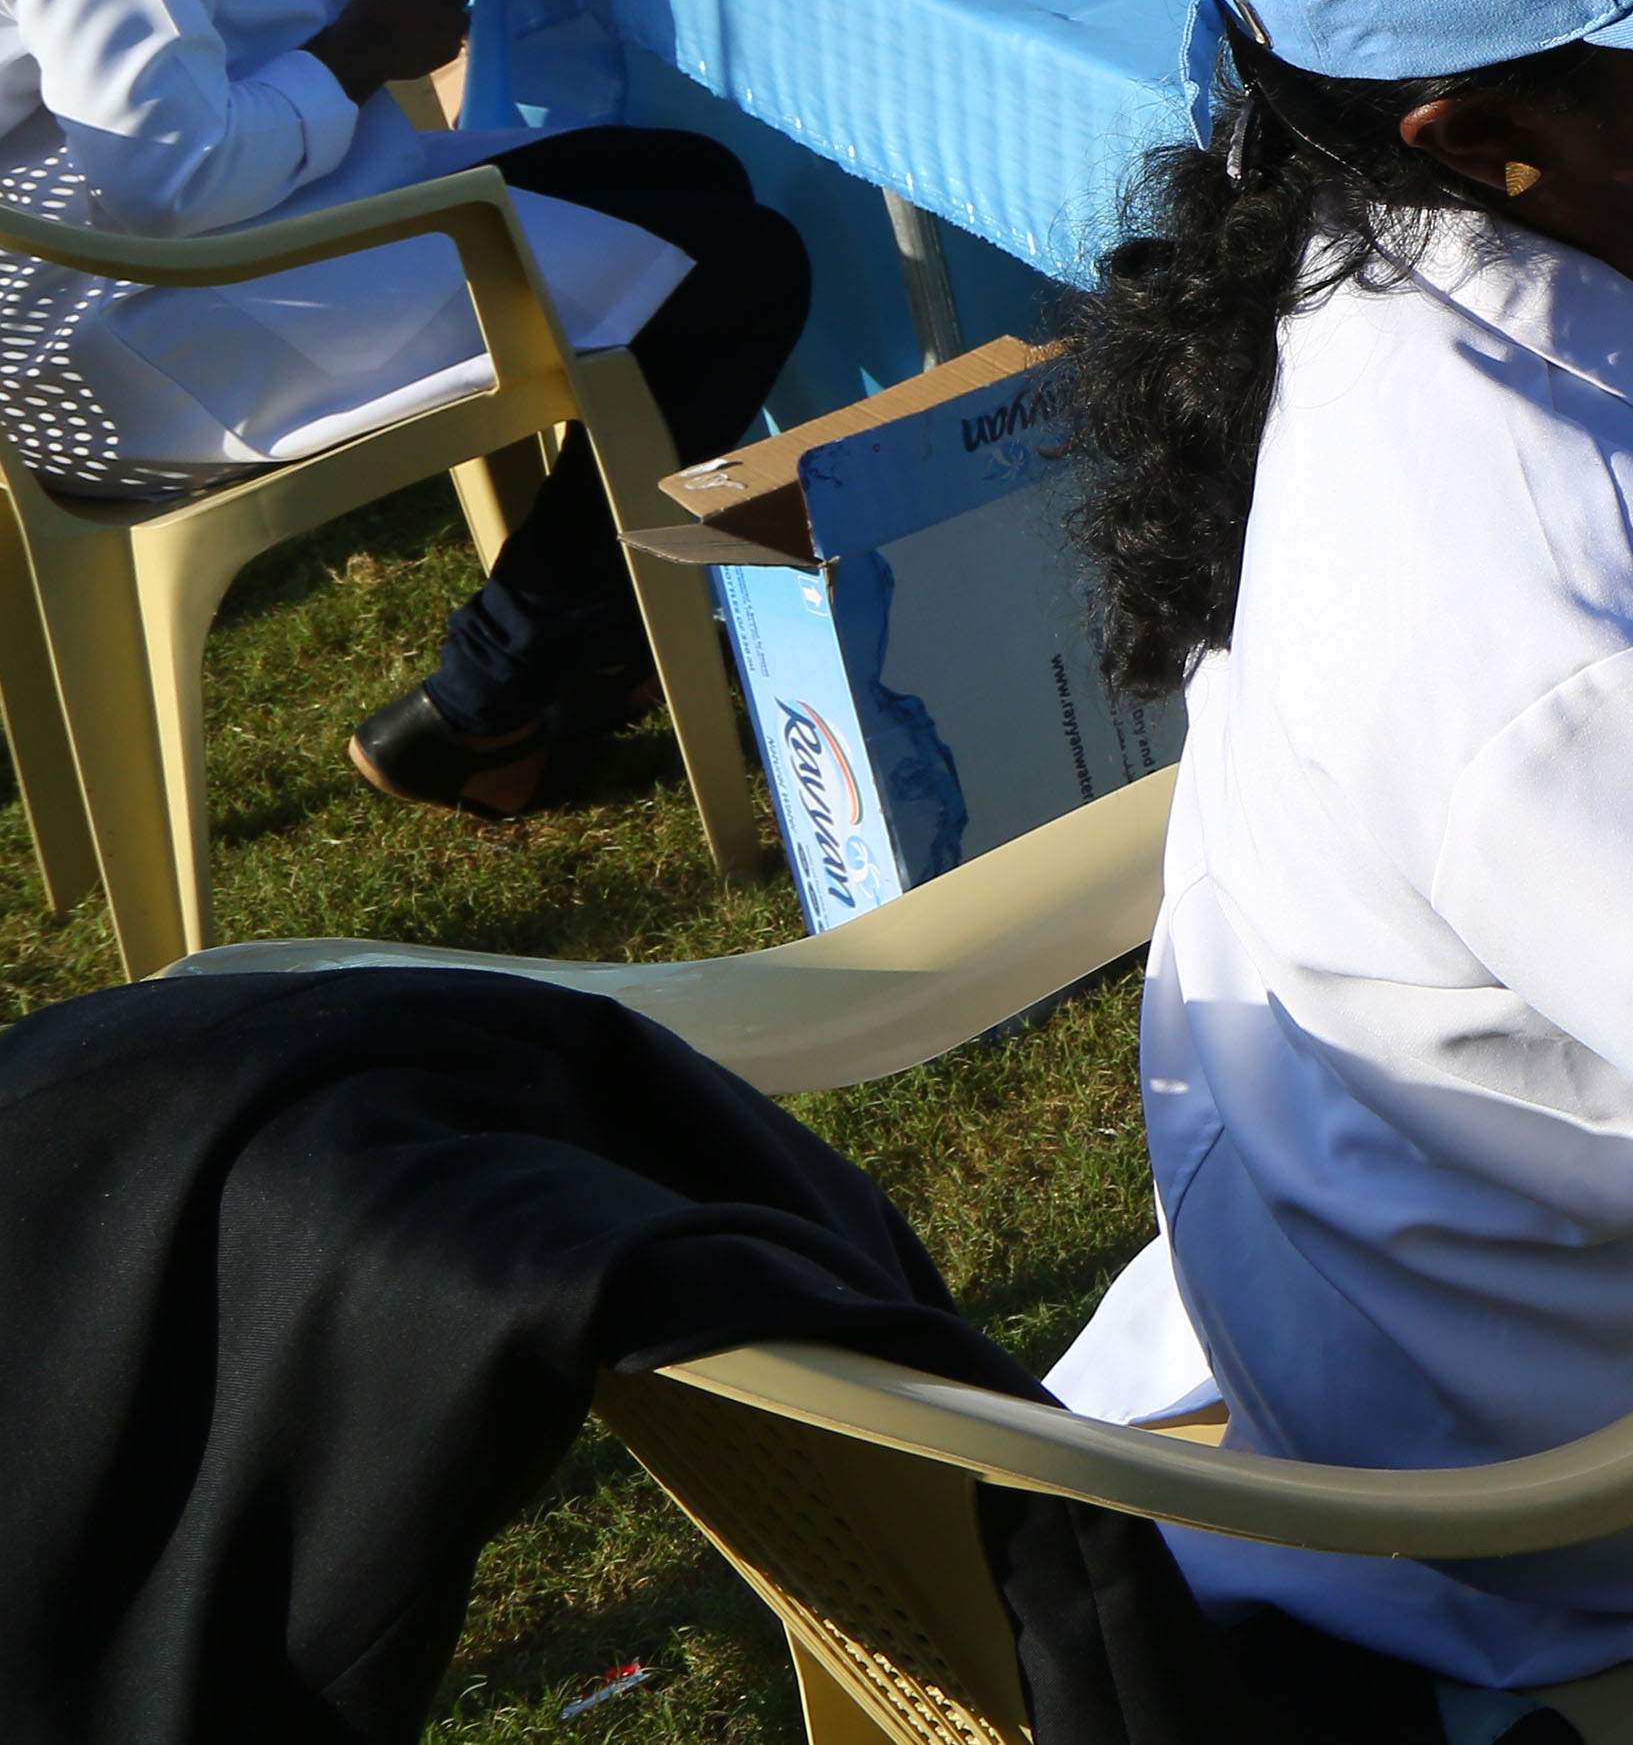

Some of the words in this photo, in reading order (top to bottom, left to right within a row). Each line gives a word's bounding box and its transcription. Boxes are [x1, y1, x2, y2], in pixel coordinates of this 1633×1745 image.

[1050, 653, 1096, 803] www.rayyanwater
[1131, 707, 1147, 735] Dry
[1138, 736, 1157, 768] and
[773, 695, 857, 910] Rayyan
